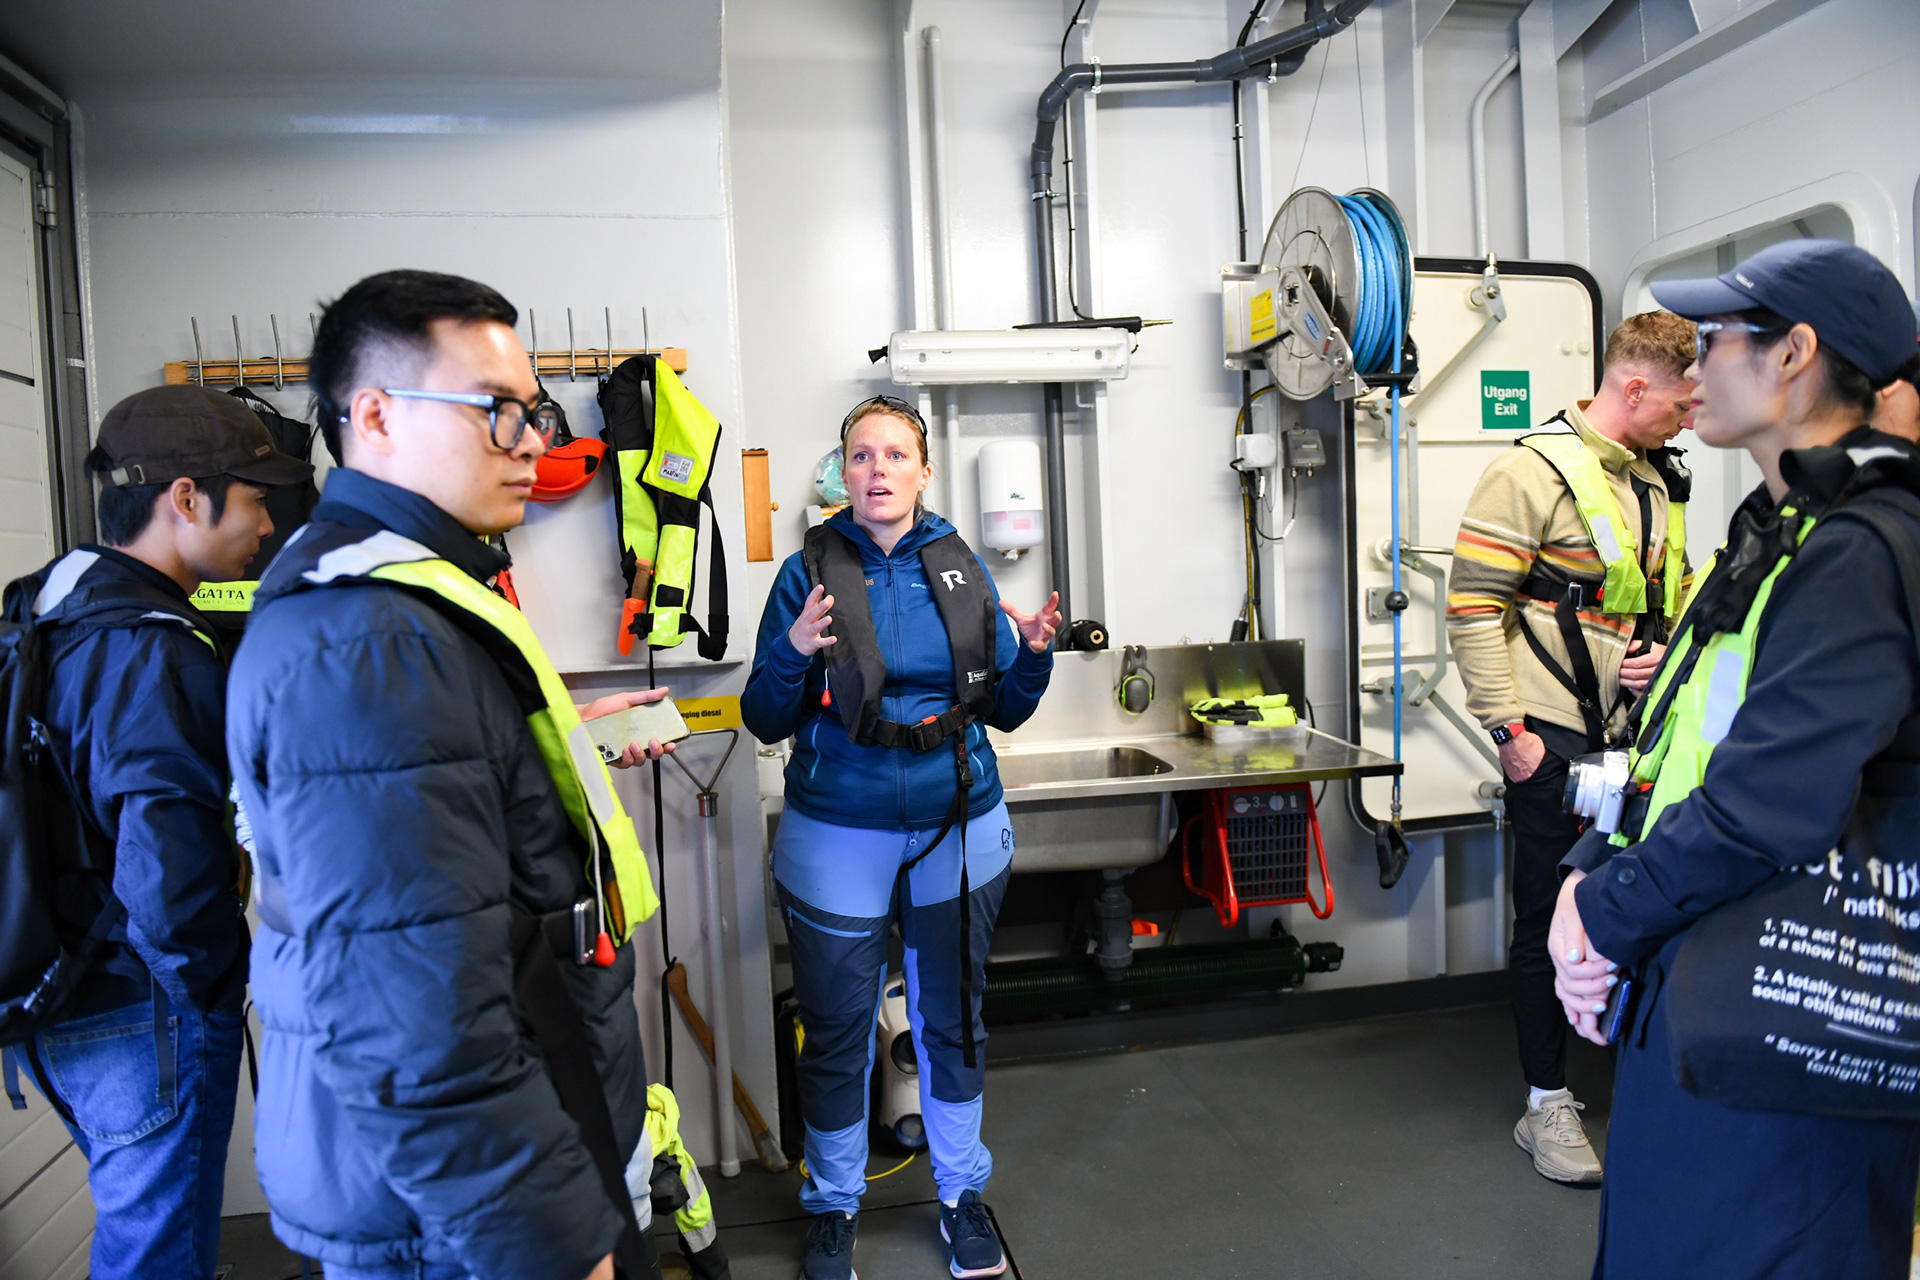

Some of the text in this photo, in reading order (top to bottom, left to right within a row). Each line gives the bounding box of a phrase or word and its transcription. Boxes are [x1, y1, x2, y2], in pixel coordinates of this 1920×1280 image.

[1484, 386, 1528, 401] Utgang
[1495, 403, 1518, 416] Exit
[701, 709, 721, 717] diesel
[1780, 918, 1809, 938] The
[1811, 927, 1837, 945] act
[1840, 935, 1857, 951] of
[1759, 933, 1777, 948] of
[1778, 937, 1789, 950] a
[1791, 939, 1836, 962] show
[1838, 948, 1854, 968] in
[1856, 958, 1885, 977] one
[1752, 984, 1801, 1006] social
[1753, 965, 1769, 983] 2.
[1770, 968, 1785, 986] A
[1787, 972, 1838, 1000] totally
[1841, 987, 1882, 1013] valid
